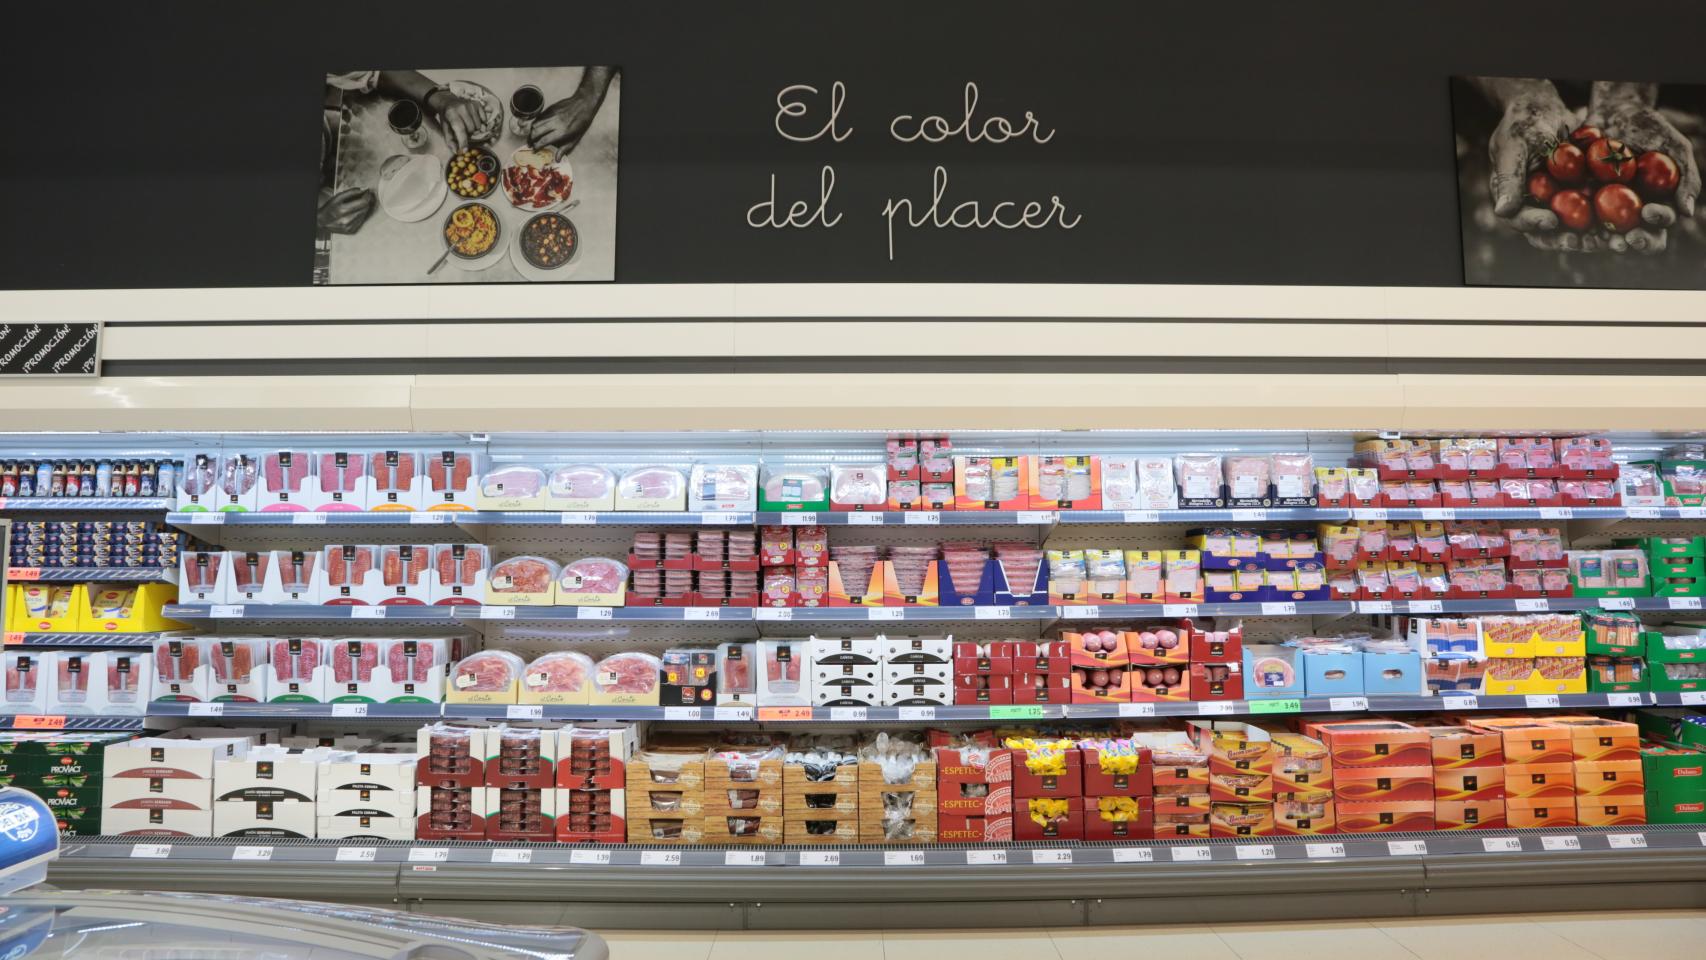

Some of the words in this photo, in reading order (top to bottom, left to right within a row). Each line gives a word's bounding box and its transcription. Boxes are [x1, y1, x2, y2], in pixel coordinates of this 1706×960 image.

[775, 81, 853, 142] El
[891, 82, 1055, 143] color
[747, 165, 843, 228] del
[882, 166, 1082, 260] placer
[22, 324, 71, 374] ¡PROMOCIÓN!
[51, 765, 83, 774] PROVIACT
[47, 798, 79, 806] PROVIACT
[1630, 837, 1645, 845] 0.59
[664, 854, 680, 862] 2.59
[992, 853, 1006, 861] 1.79
